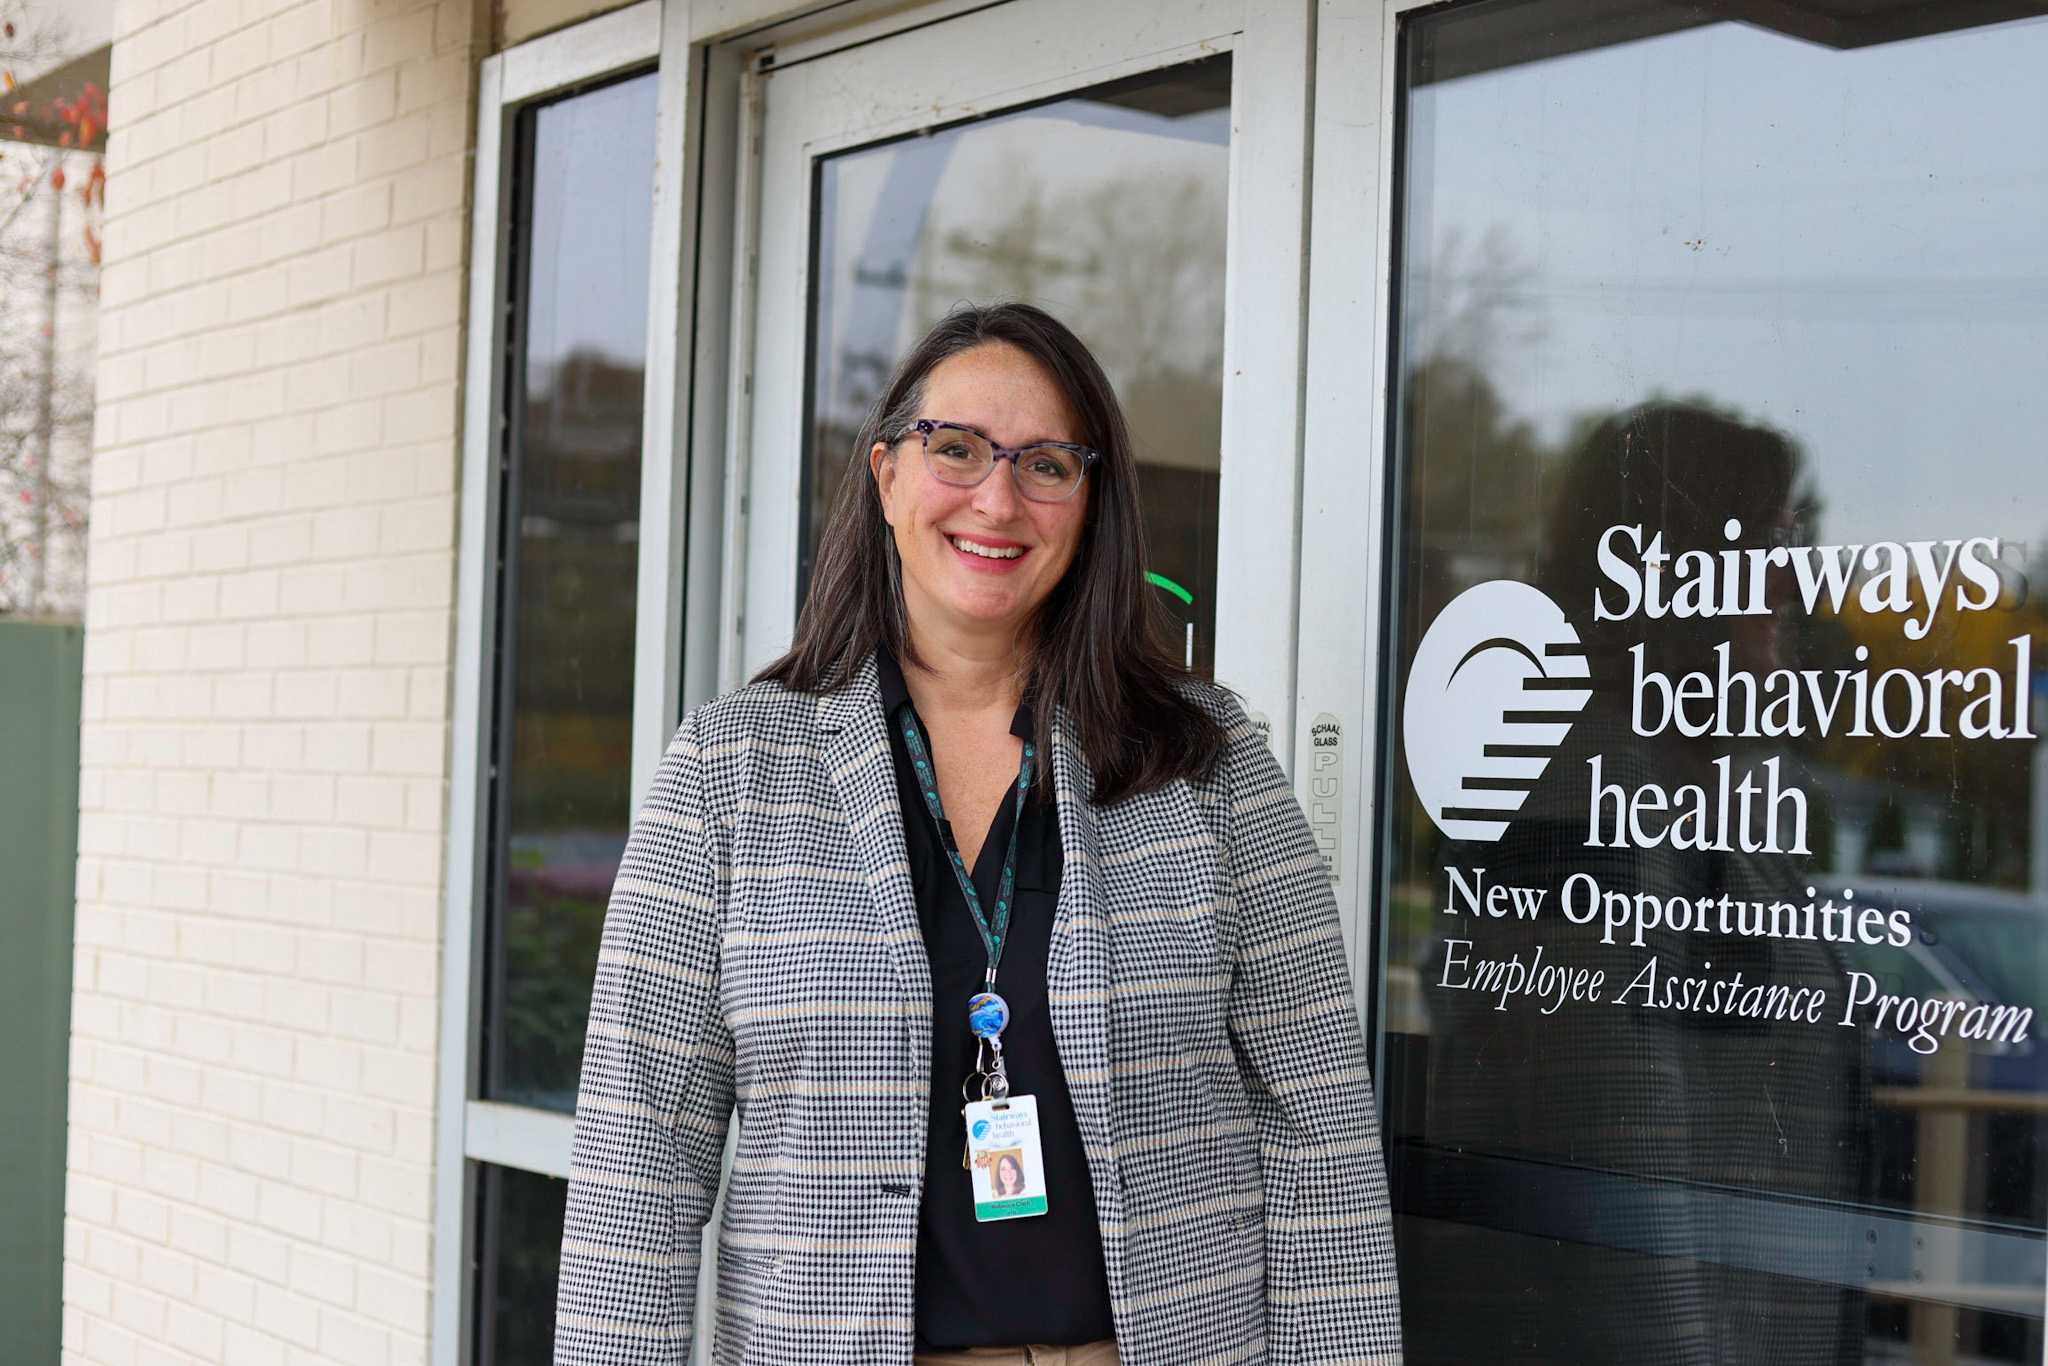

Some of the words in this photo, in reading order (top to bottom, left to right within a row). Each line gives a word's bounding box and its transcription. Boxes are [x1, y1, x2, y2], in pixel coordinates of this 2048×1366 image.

[1595, 519, 1999, 640] Stairways
[1311, 723, 1340, 737] SCHAAL
[1629, 635, 2037, 739] behavioral
[1313, 737, 1338, 747] GLASS
[1312, 752, 1338, 849] PULL
[1583, 755, 1812, 855] health
[1444, 867, 1548, 920] New
[1562, 874, 1911, 947] Opportunities
[1437, 940, 1605, 1015] Employee
[1612, 957, 1826, 1024] Assistance
[1838, 972, 2034, 1055] Program
